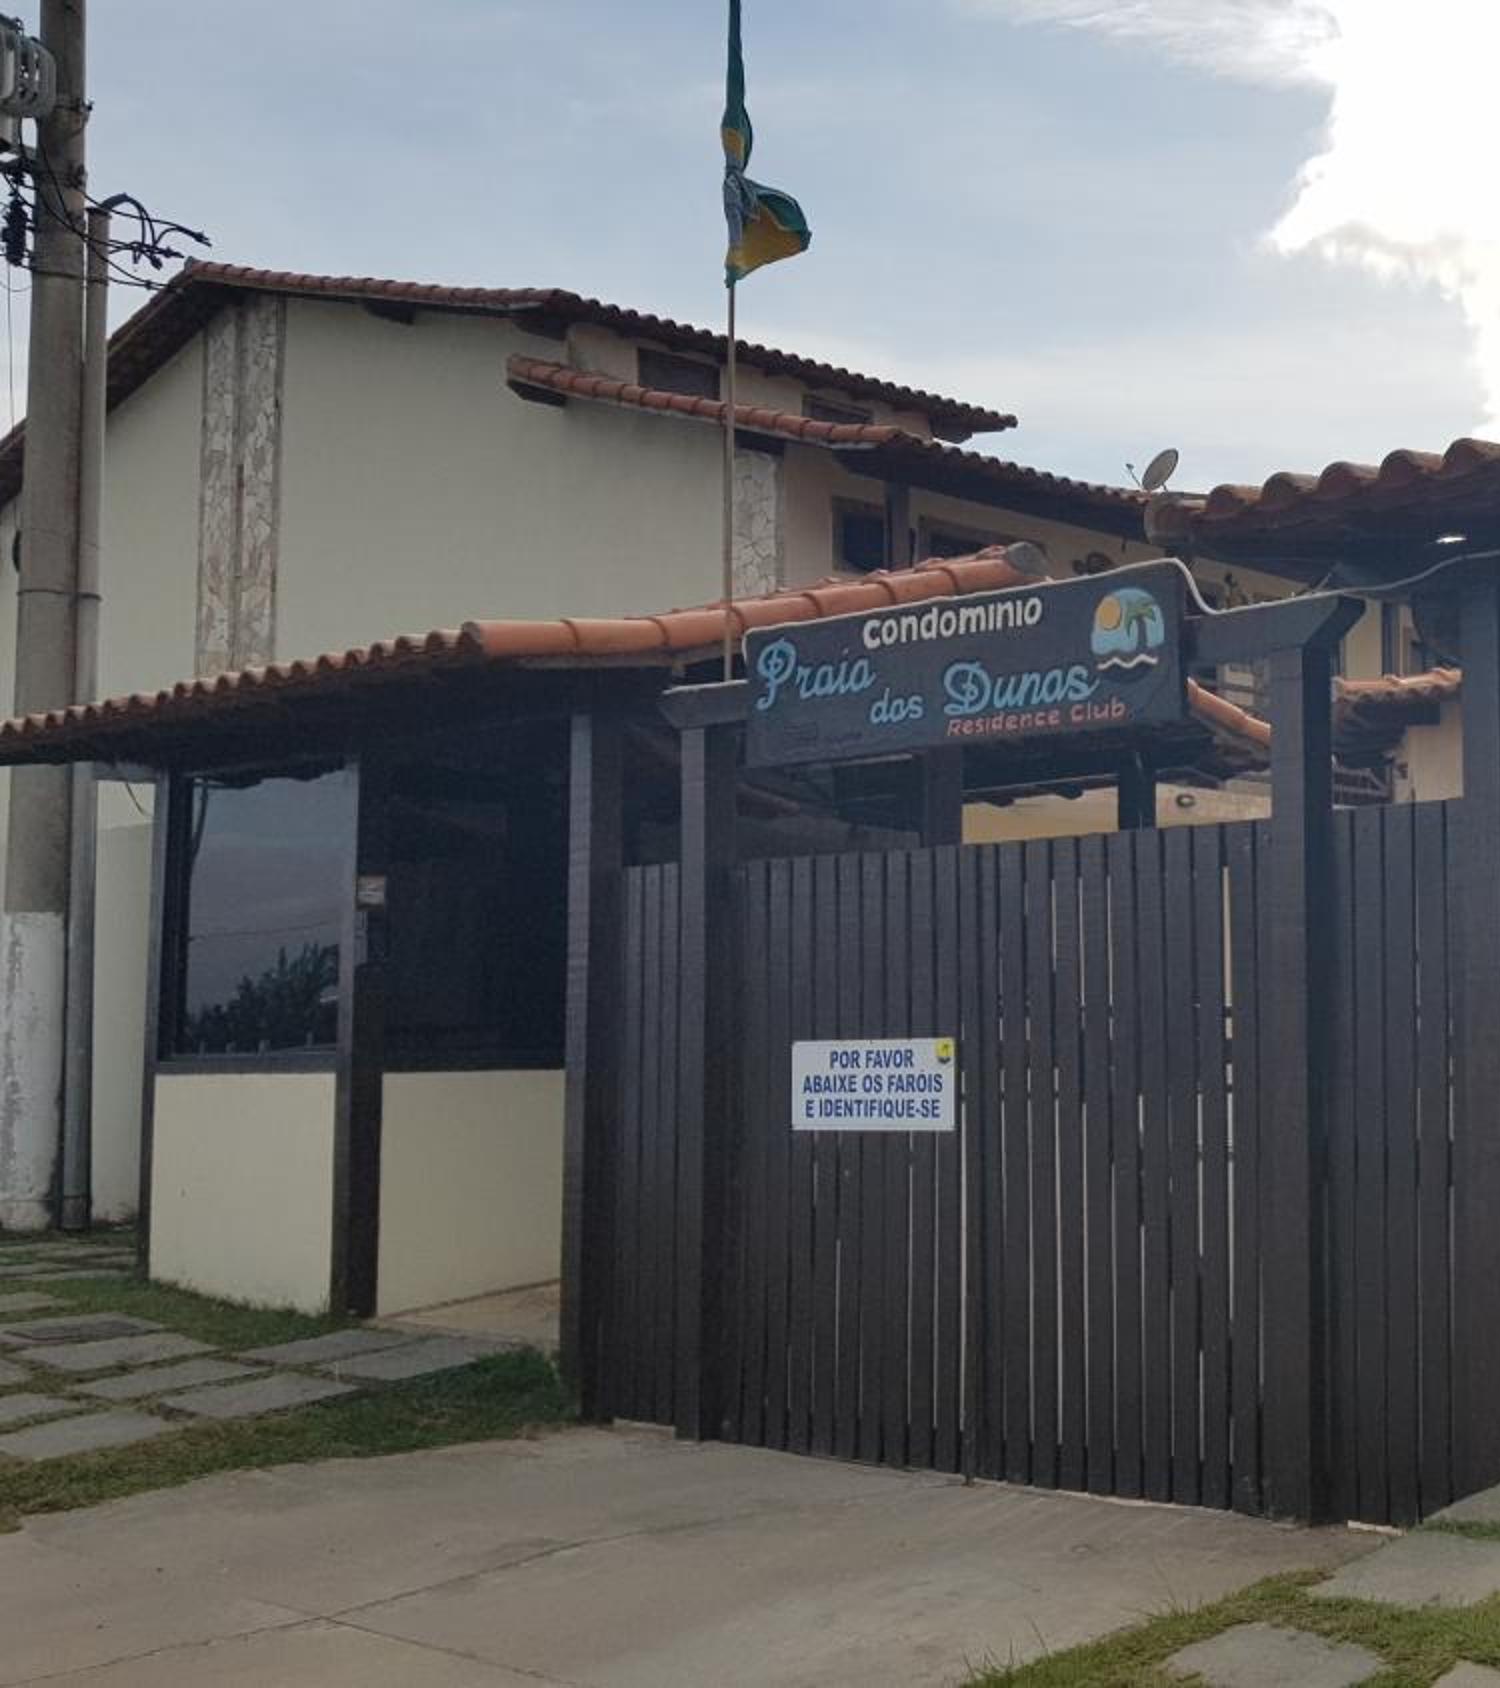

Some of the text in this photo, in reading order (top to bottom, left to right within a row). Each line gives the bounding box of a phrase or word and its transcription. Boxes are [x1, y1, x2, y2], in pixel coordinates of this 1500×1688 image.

[756, 638, 876, 711] Praia
[944, 661, 1099, 715] Dunas
[948, 698, 1126, 736] Residence Club
[830, 1049, 914, 1069] POR FAVOR
[803, 1075, 857, 1094] ABAIXE
[862, 1074, 884, 1093] OS
[806, 1099, 940, 1119] E IDENTIFIQUE-SE
